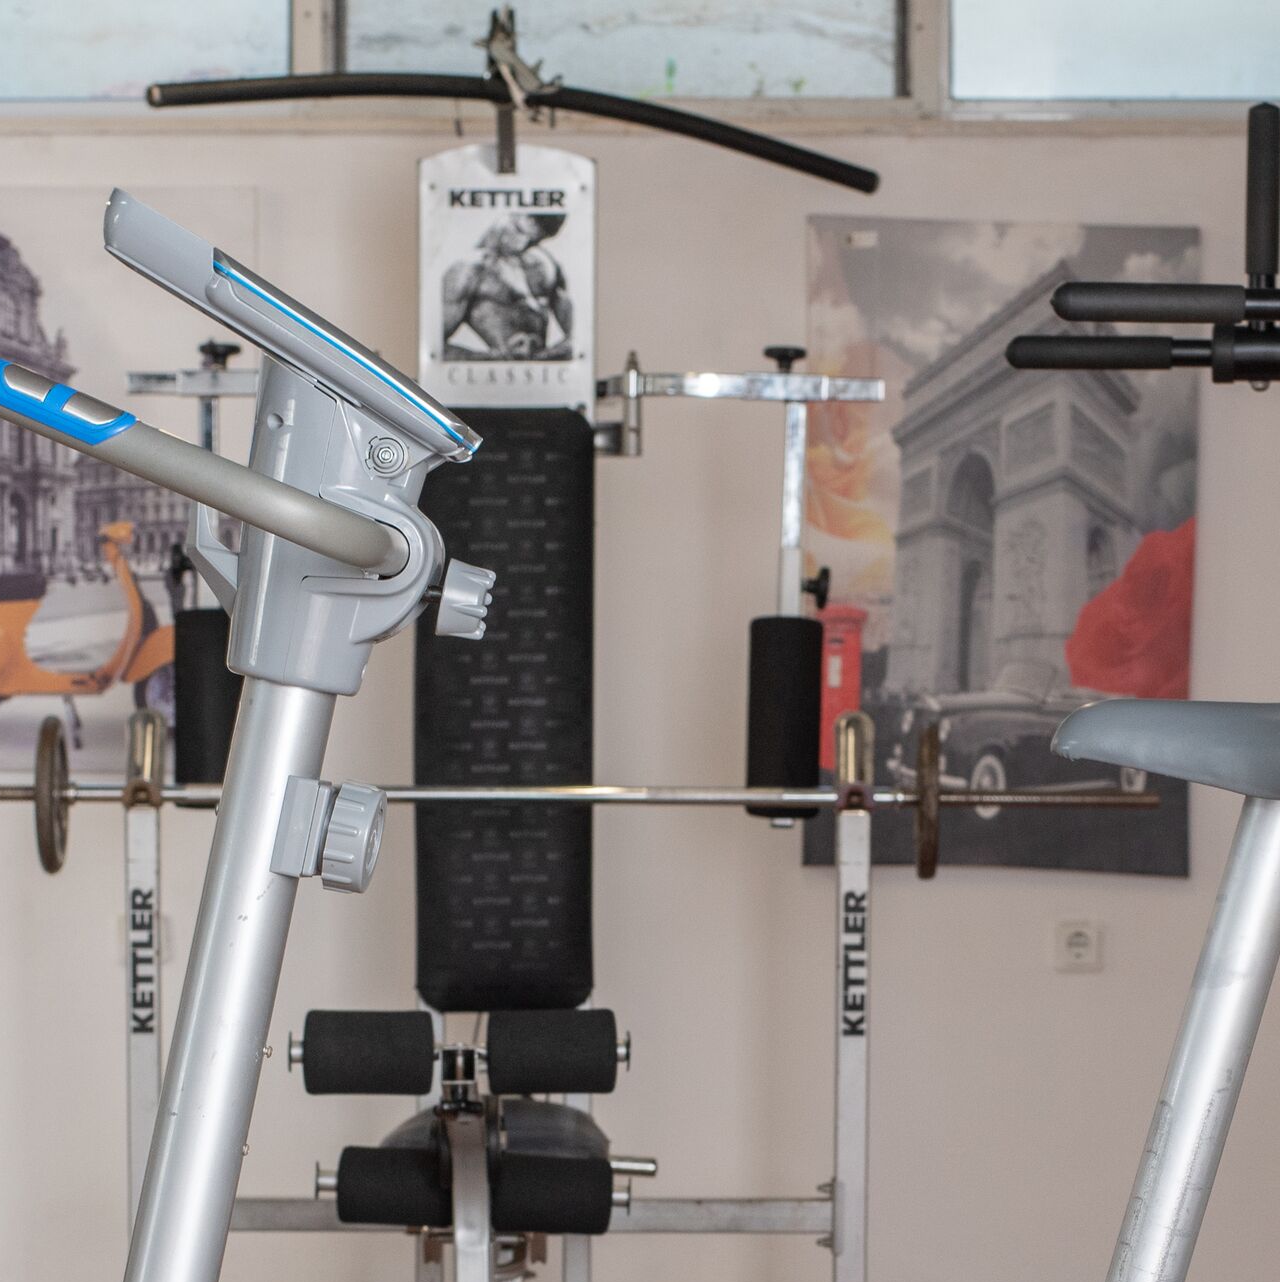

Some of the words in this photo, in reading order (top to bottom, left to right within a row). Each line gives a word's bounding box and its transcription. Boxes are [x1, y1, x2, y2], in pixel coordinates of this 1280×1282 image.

[450, 189, 564, 208] KETTLER
[448, 366, 570, 386] CLASSIC
[131, 888, 153, 1034] KETTLER
[842, 891, 866, 1037] KETTLER
